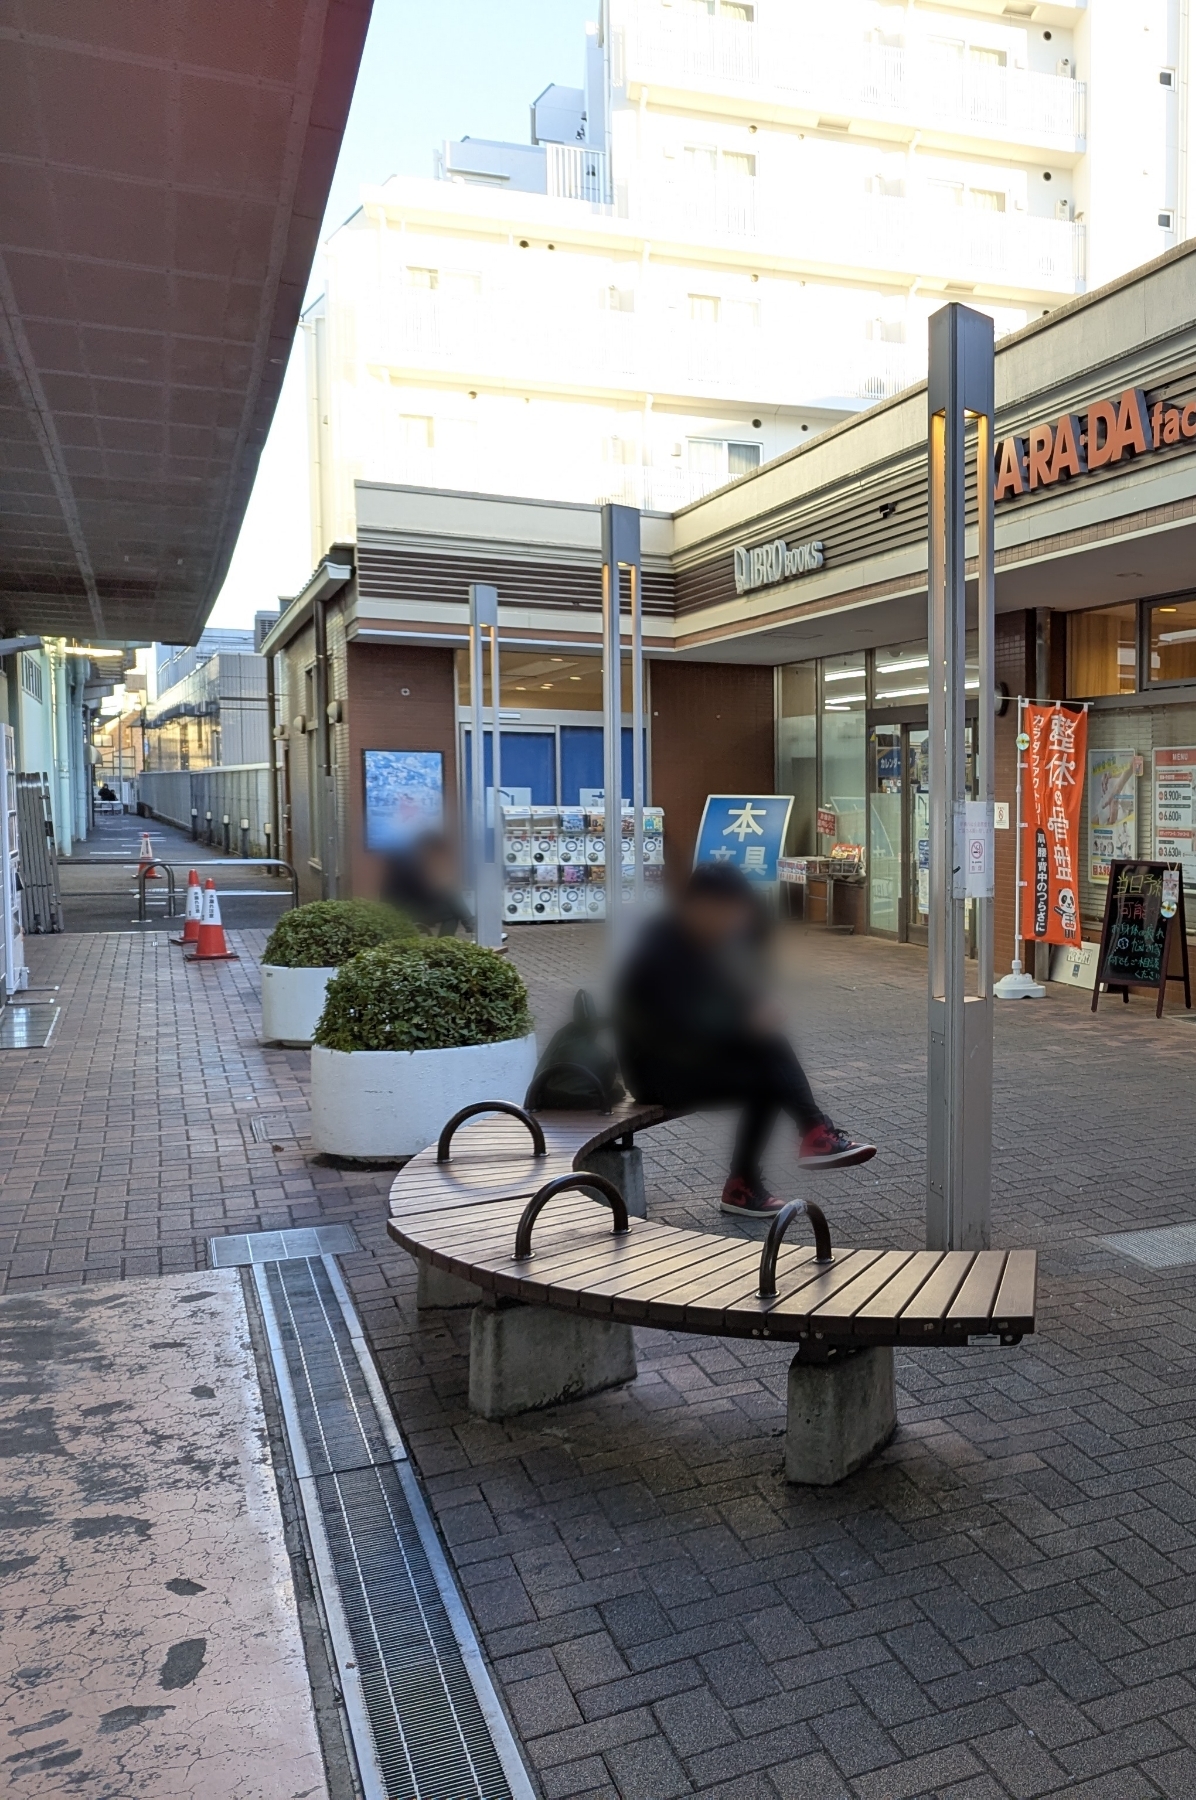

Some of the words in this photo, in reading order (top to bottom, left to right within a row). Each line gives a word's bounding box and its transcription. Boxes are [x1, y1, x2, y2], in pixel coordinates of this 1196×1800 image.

[994, 388, 1149, 500] A·RA·DA
[785, 541, 823, 576] BOOKS
[1032, 714, 1044, 825] カラダファクトリー
[1172, 753, 1189, 761] MENU
[722, 802, 767, 842] 本
